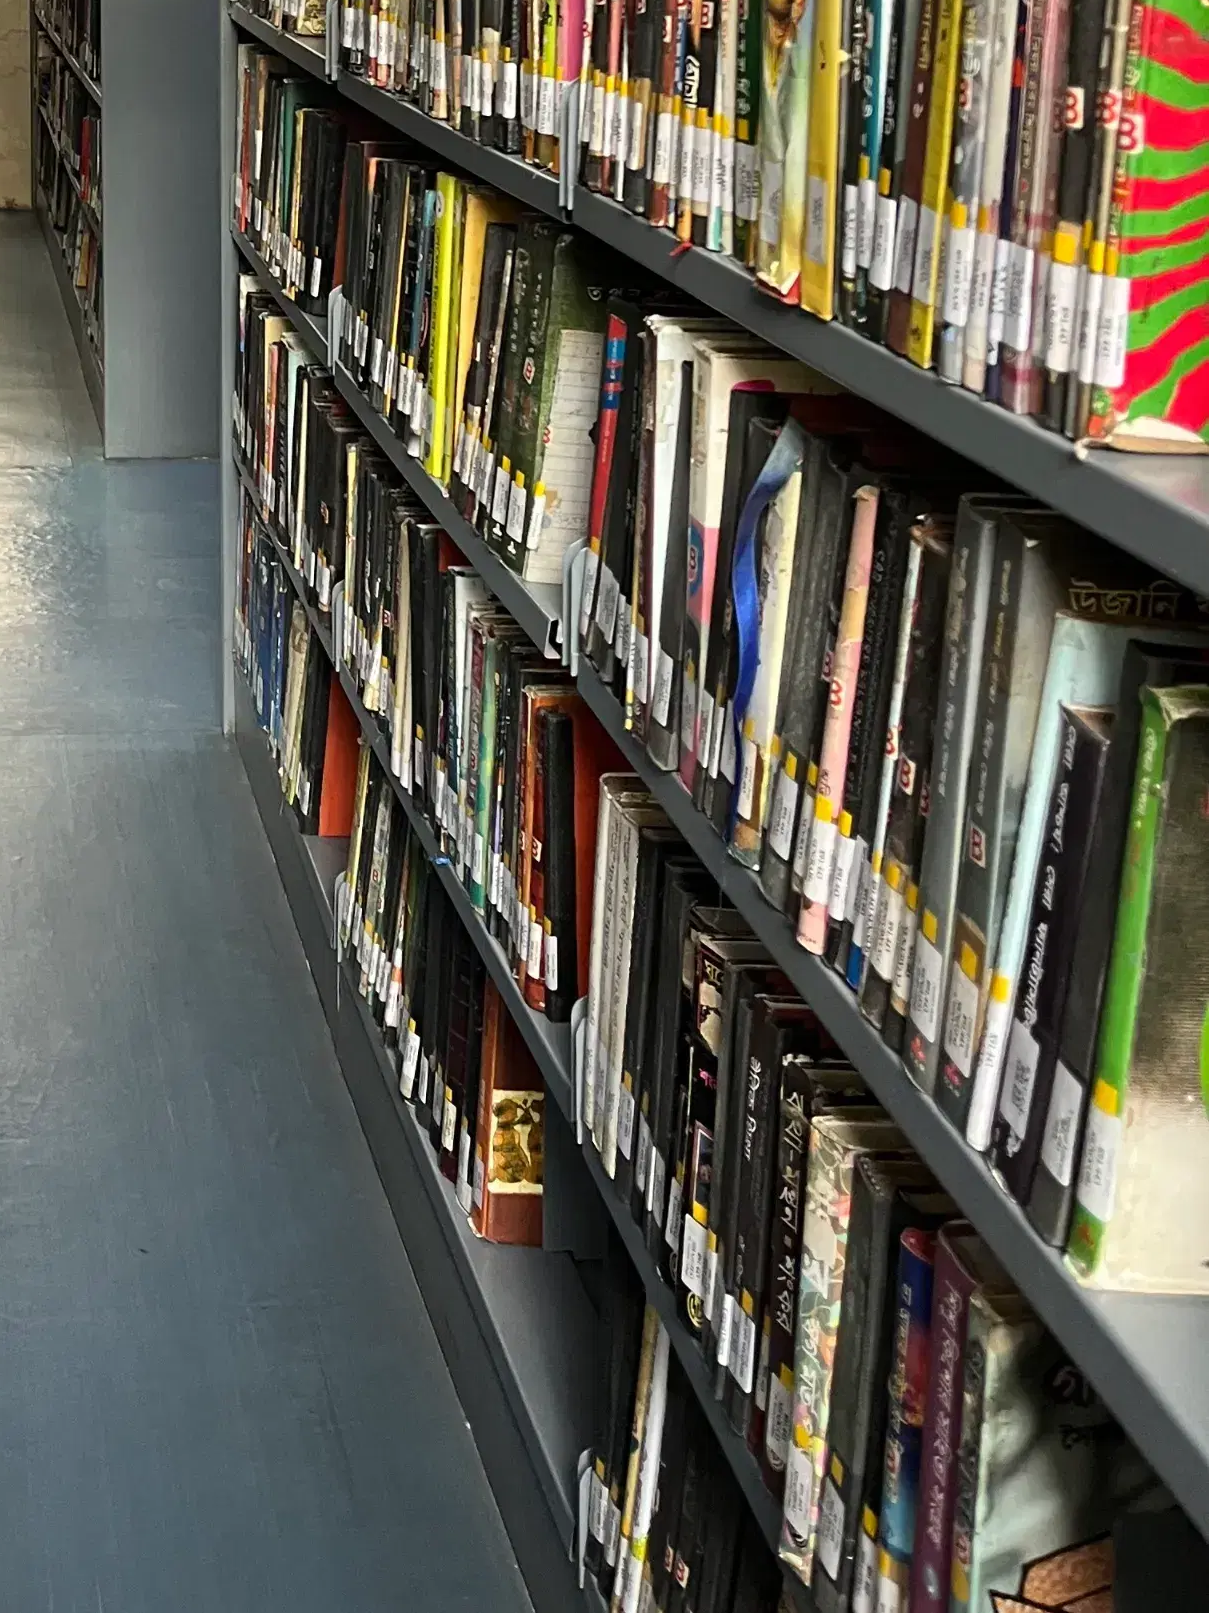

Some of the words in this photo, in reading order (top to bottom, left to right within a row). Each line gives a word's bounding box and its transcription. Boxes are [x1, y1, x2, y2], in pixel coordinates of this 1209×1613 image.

[702, 7, 710, 25] B
[1066, 91, 1078, 124] B
[1119, 117, 1137, 151] B
[1064, 725, 1076, 769] সেরা
[970, 828, 984, 860] B
[1042, 864, 1055, 910] সেরা
[777, 1255, 794, 1336] শংকর
